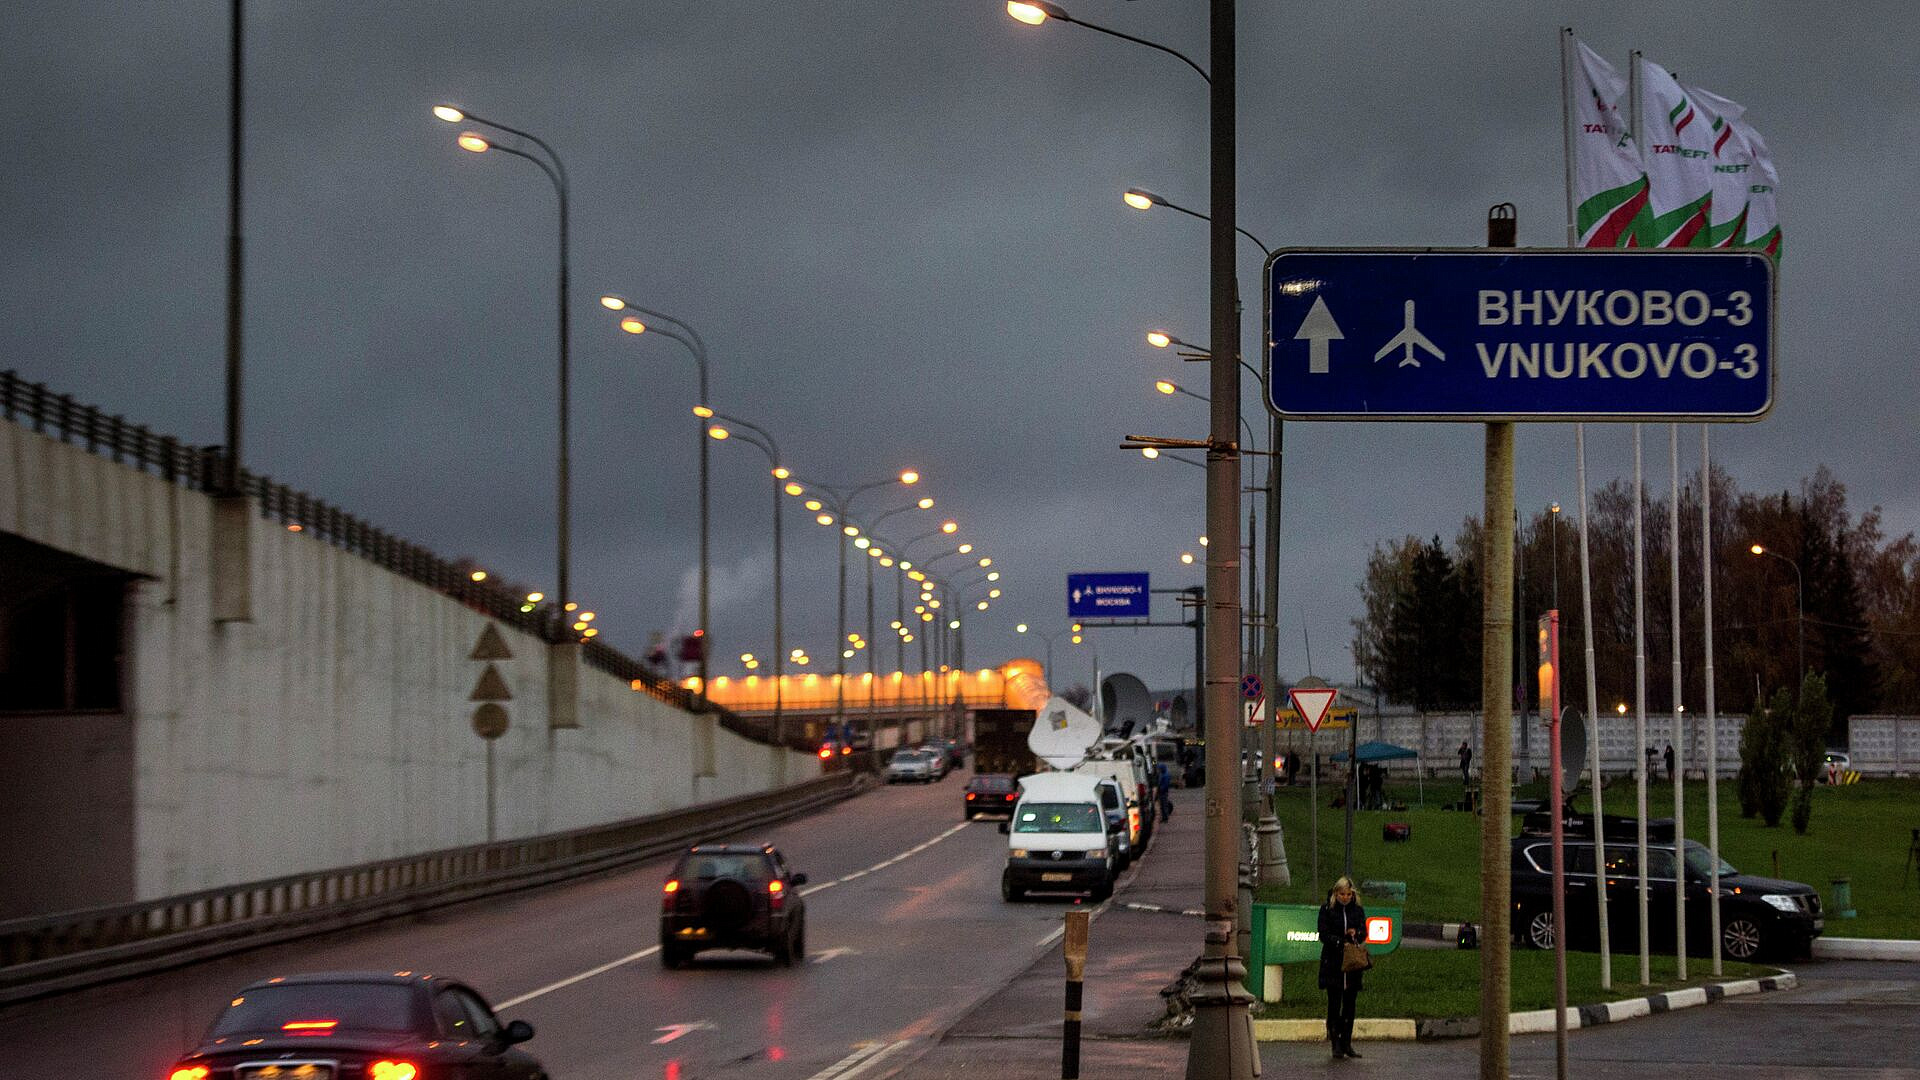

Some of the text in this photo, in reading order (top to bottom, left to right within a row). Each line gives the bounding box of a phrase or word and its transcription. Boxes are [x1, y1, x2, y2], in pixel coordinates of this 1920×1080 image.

[1653, 144, 1710, 160] TATNEFT
[1478, 289, 1753, 327] ВНУКОВО-3
[1476, 342, 1760, 380] VNUKOVO-3
